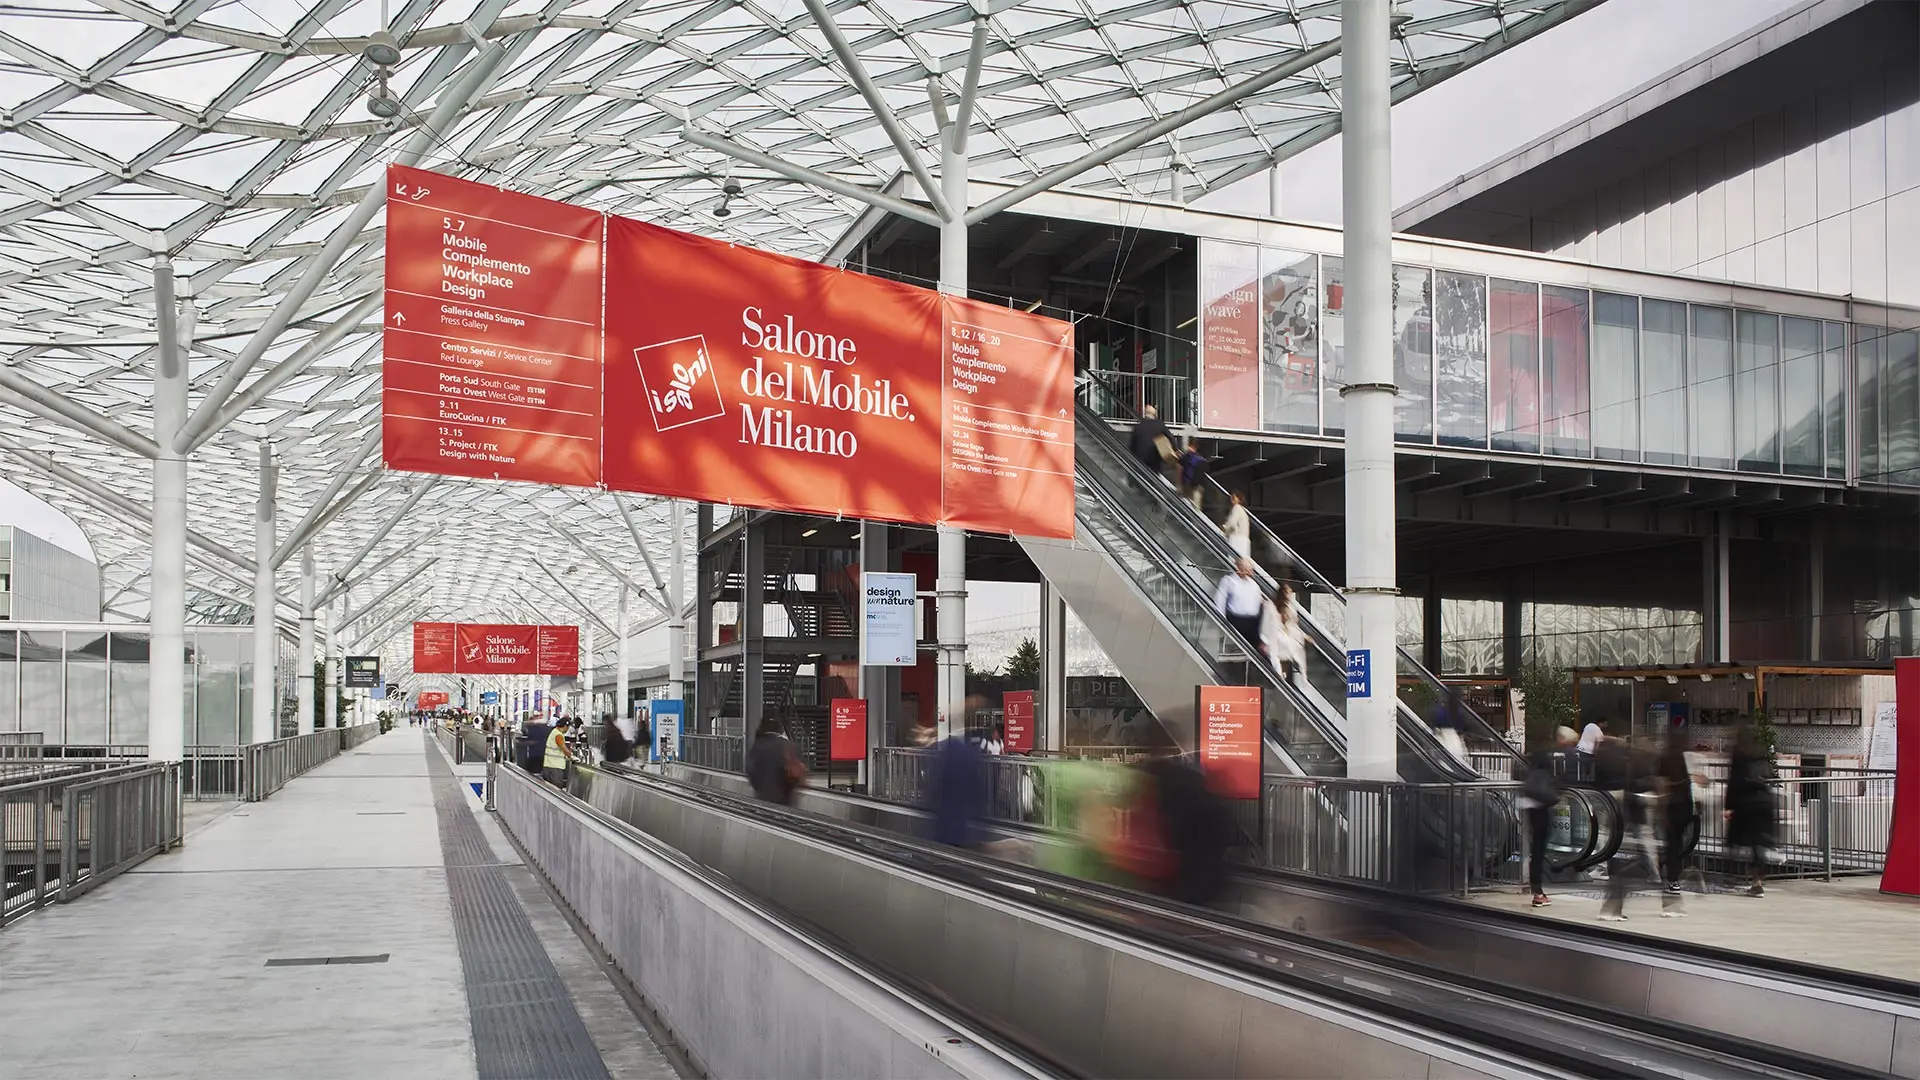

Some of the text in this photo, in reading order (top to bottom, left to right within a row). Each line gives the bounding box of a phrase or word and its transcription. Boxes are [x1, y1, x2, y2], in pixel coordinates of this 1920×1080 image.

[444, 217, 465, 232] 5_7
[443, 233, 487, 252] Mobile
[442, 248, 531, 275] Complemento
[442, 264, 513, 288] Workplace
[442, 280, 485, 300] Design
[441, 304, 525, 326] Galleria della Stampa
[1207, 305, 1240, 318] wave
[440, 315, 488, 332] Press Gallery
[742, 306, 857, 365] Salone
[441, 342, 468, 352] Centro
[470, 346, 496, 357] Servizi
[503, 352, 527, 362] Service
[528, 356, 552, 366] Center
[952, 342, 980, 356] Mobile
[440, 352, 484, 368] Red Lounge
[952, 353, 1006, 374] Complemento
[440, 372, 461, 383] Porta
[464, 376, 479, 386] Sud
[480, 378, 502, 389] South
[504, 382, 520, 392] Gate
[952, 366, 996, 384] Workplace
[440, 384, 461, 394] Porta
[463, 387, 486, 398] Ovest
[488, 390, 506, 400] West
[508, 393, 526, 402] Gate
[740, 356, 916, 422] del Mobile.
[952, 378, 978, 394] Design
[440, 400, 459, 410] 9_11
[440, 410, 484, 423] EuroCucina
[492, 416, 506, 426] FTK
[952, 414, 972, 424] Mobile
[972, 418, 1010, 431] Complemento
[438, 427, 463, 436] 13_15
[738, 402, 858, 458] Milano
[440, 438, 448, 446] S.
[449, 440, 476, 450] Project
[484, 443, 498, 452] FTK
[440, 448, 516, 464] Design with Nature
[866, 587, 900, 598] design
[880, 598, 914, 606] nature
[486, 635, 515, 644] Salone
[486, 645, 499, 654] del
[500, 645, 531, 654] Mobile.
[486, 655, 516, 664] Milano
[1357, 670, 1365, 678] by
[1348, 682, 1365, 692] TIM
[1209, 704, 1230, 714] 8_12
